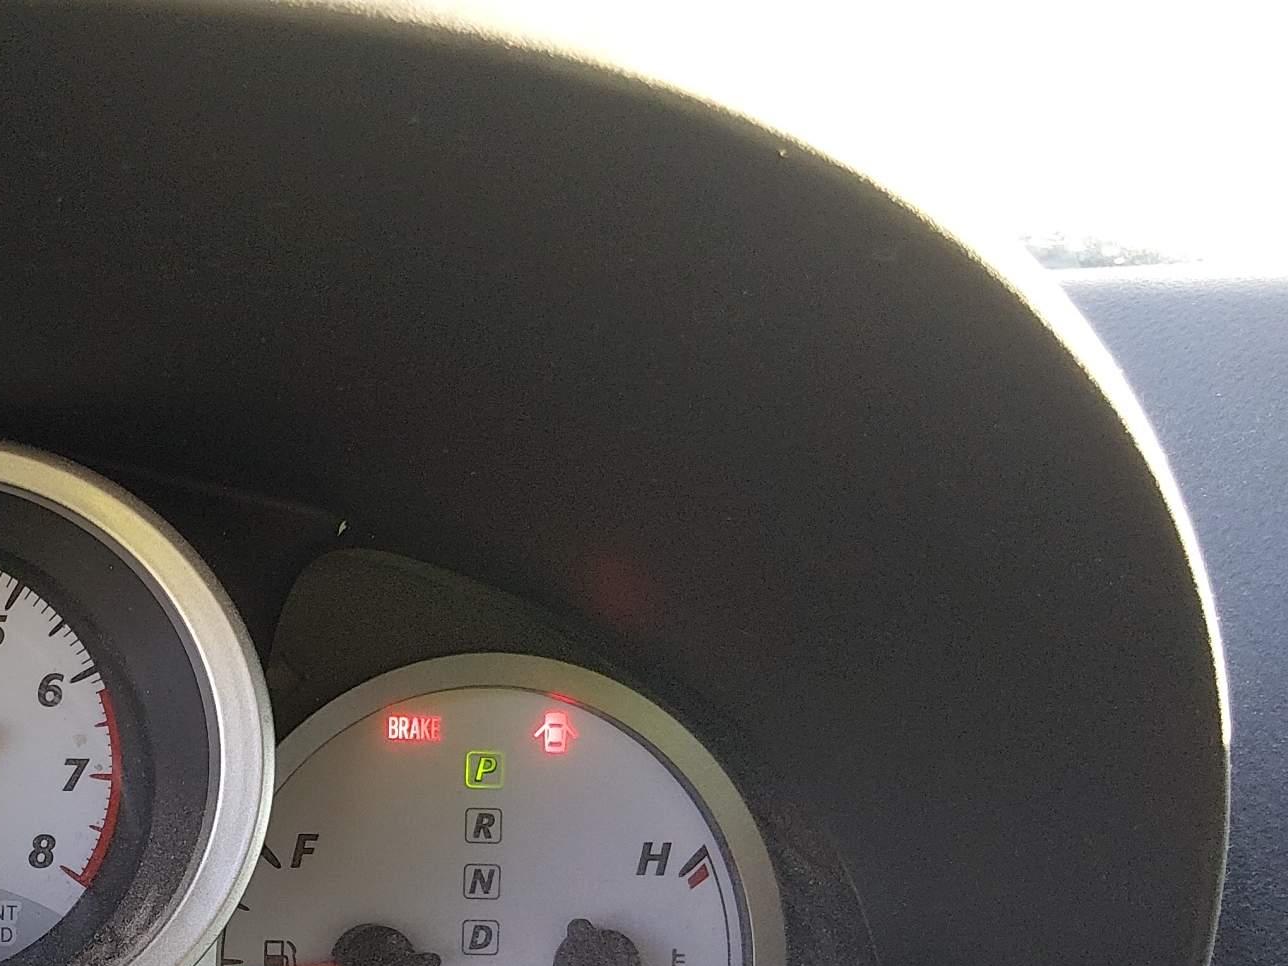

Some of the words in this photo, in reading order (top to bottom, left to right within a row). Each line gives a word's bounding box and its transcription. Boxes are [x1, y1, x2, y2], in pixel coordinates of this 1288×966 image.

[37, 672, 65, 707] 6
[387, 716, 442, 742] BRAKE
[62, 757, 91, 792] 7
[475, 757, 497, 782] P
[473, 812, 497, 838] R
[28, 833, 58, 869] 8
[289, 832, 320, 869] F
[635, 841, 672, 877] H
[469, 869, 495, 895] N
[469, 925, 494, 950] D
